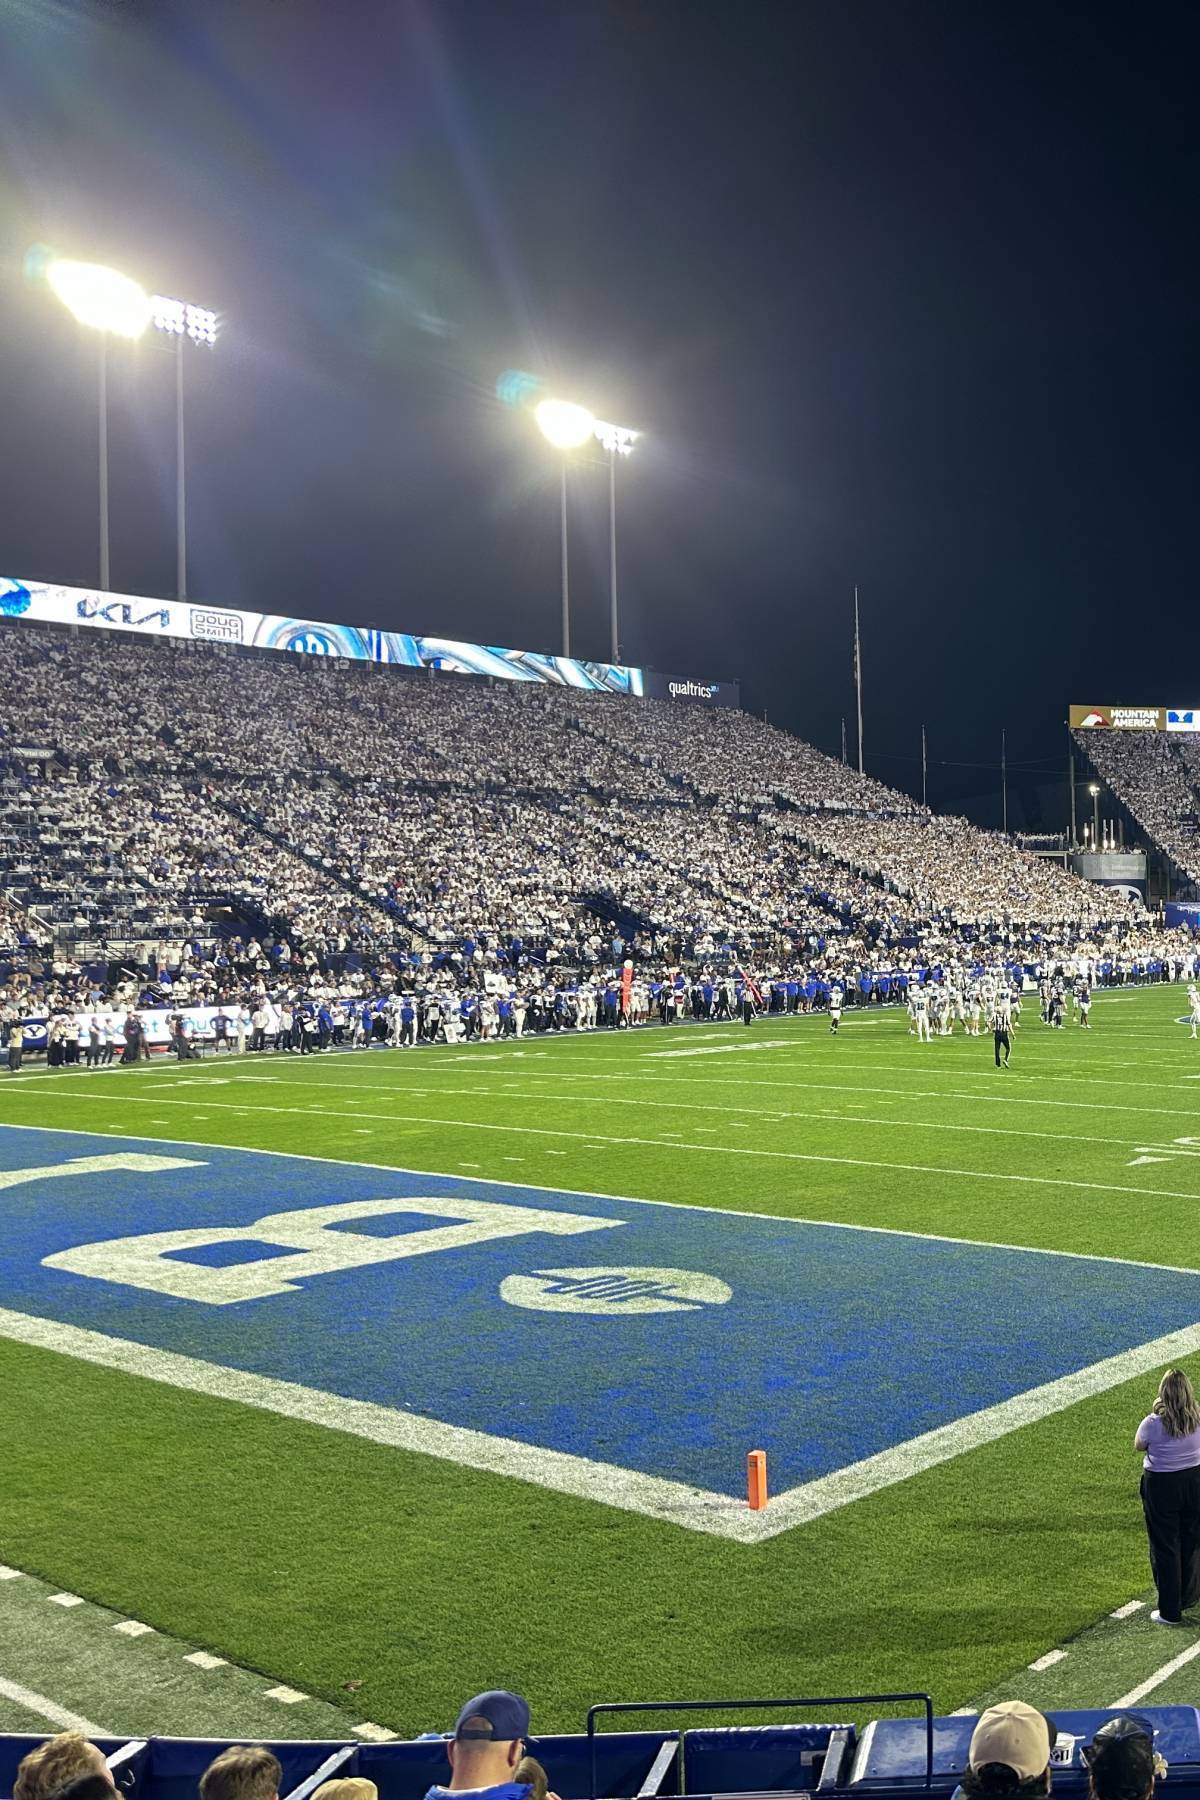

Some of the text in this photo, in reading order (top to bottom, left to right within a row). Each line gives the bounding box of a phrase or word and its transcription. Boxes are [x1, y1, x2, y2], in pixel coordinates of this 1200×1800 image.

[194, 612, 239, 629] DOUG
[668, 680, 712, 699] qualtrics
[1110, 709, 1160, 719] MOUNTAIN
[1113, 718, 1157, 728] AMERICA
